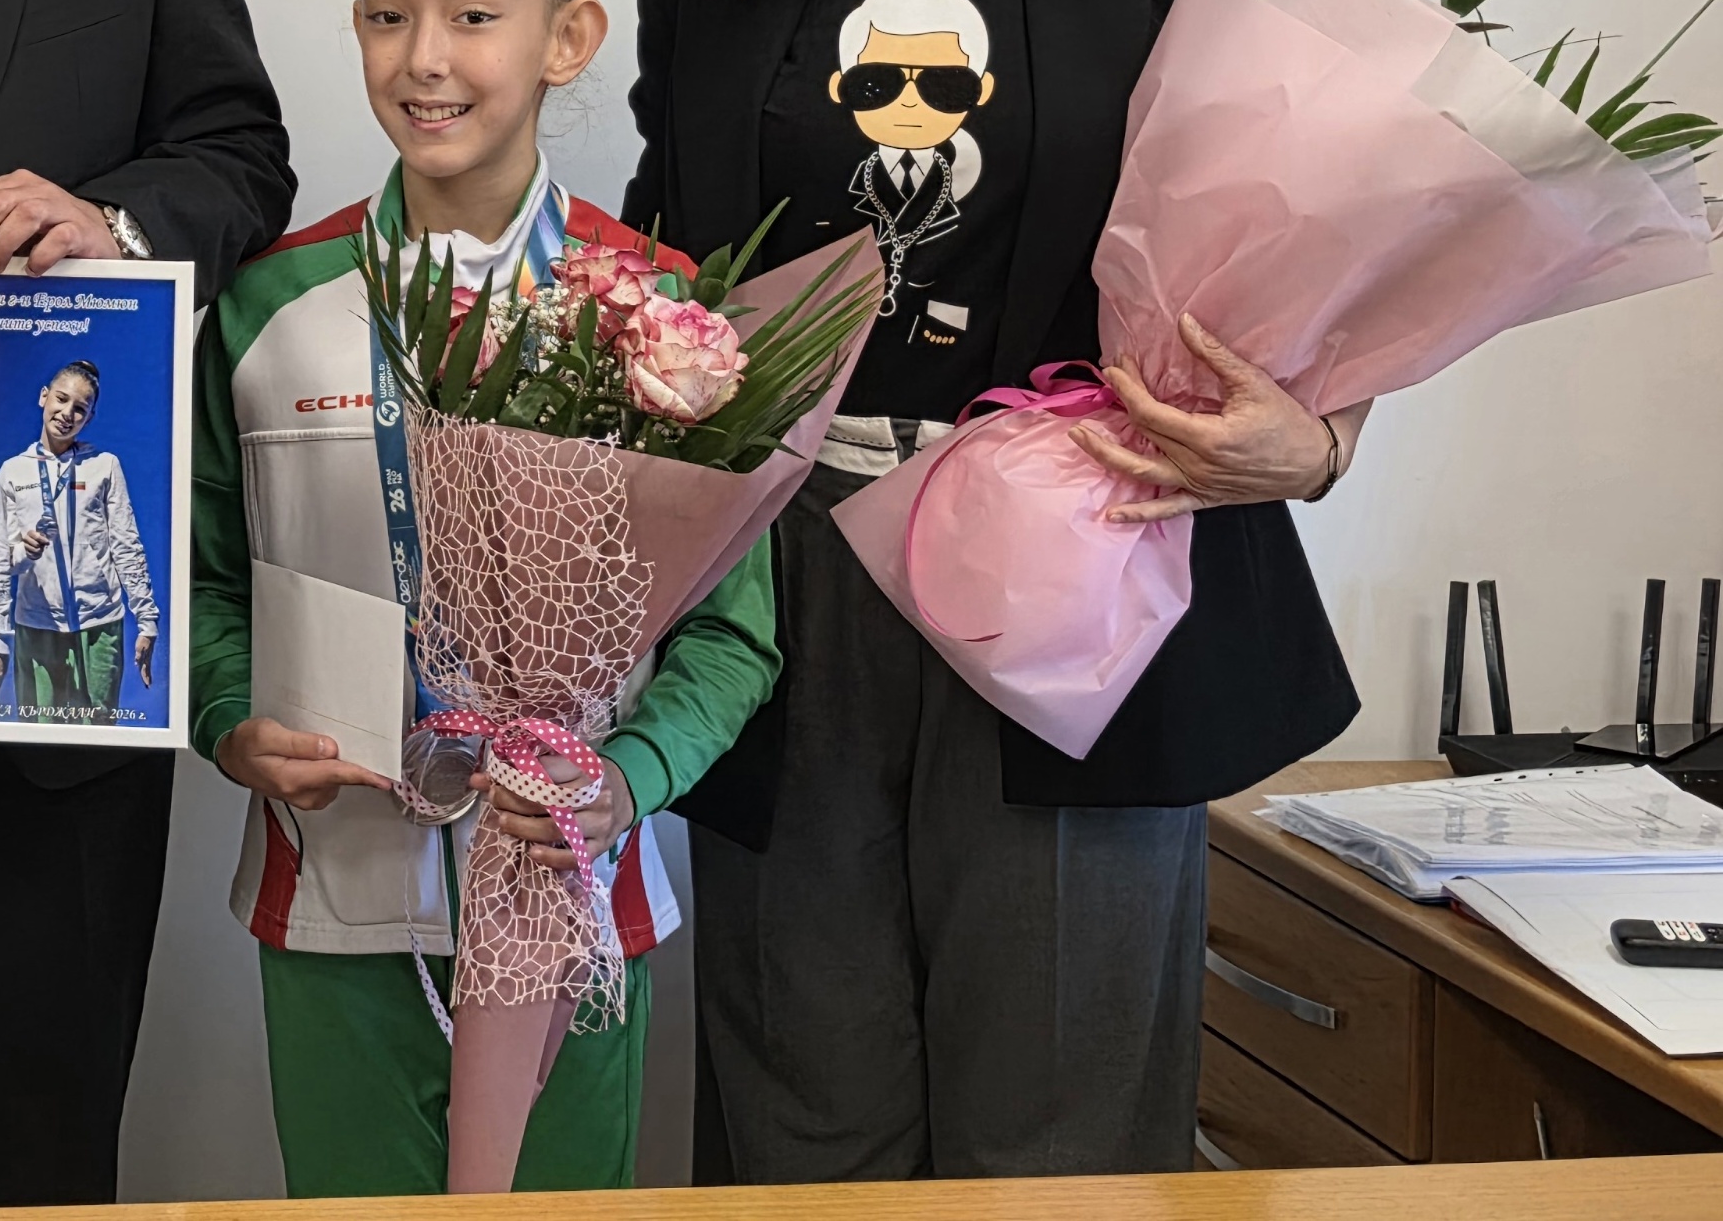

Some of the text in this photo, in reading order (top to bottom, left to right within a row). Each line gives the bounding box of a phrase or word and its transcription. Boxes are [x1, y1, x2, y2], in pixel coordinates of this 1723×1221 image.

[378, 363, 387, 399] WORLD
[389, 488, 406, 513] 26
[109, 707, 136, 720] 2026
